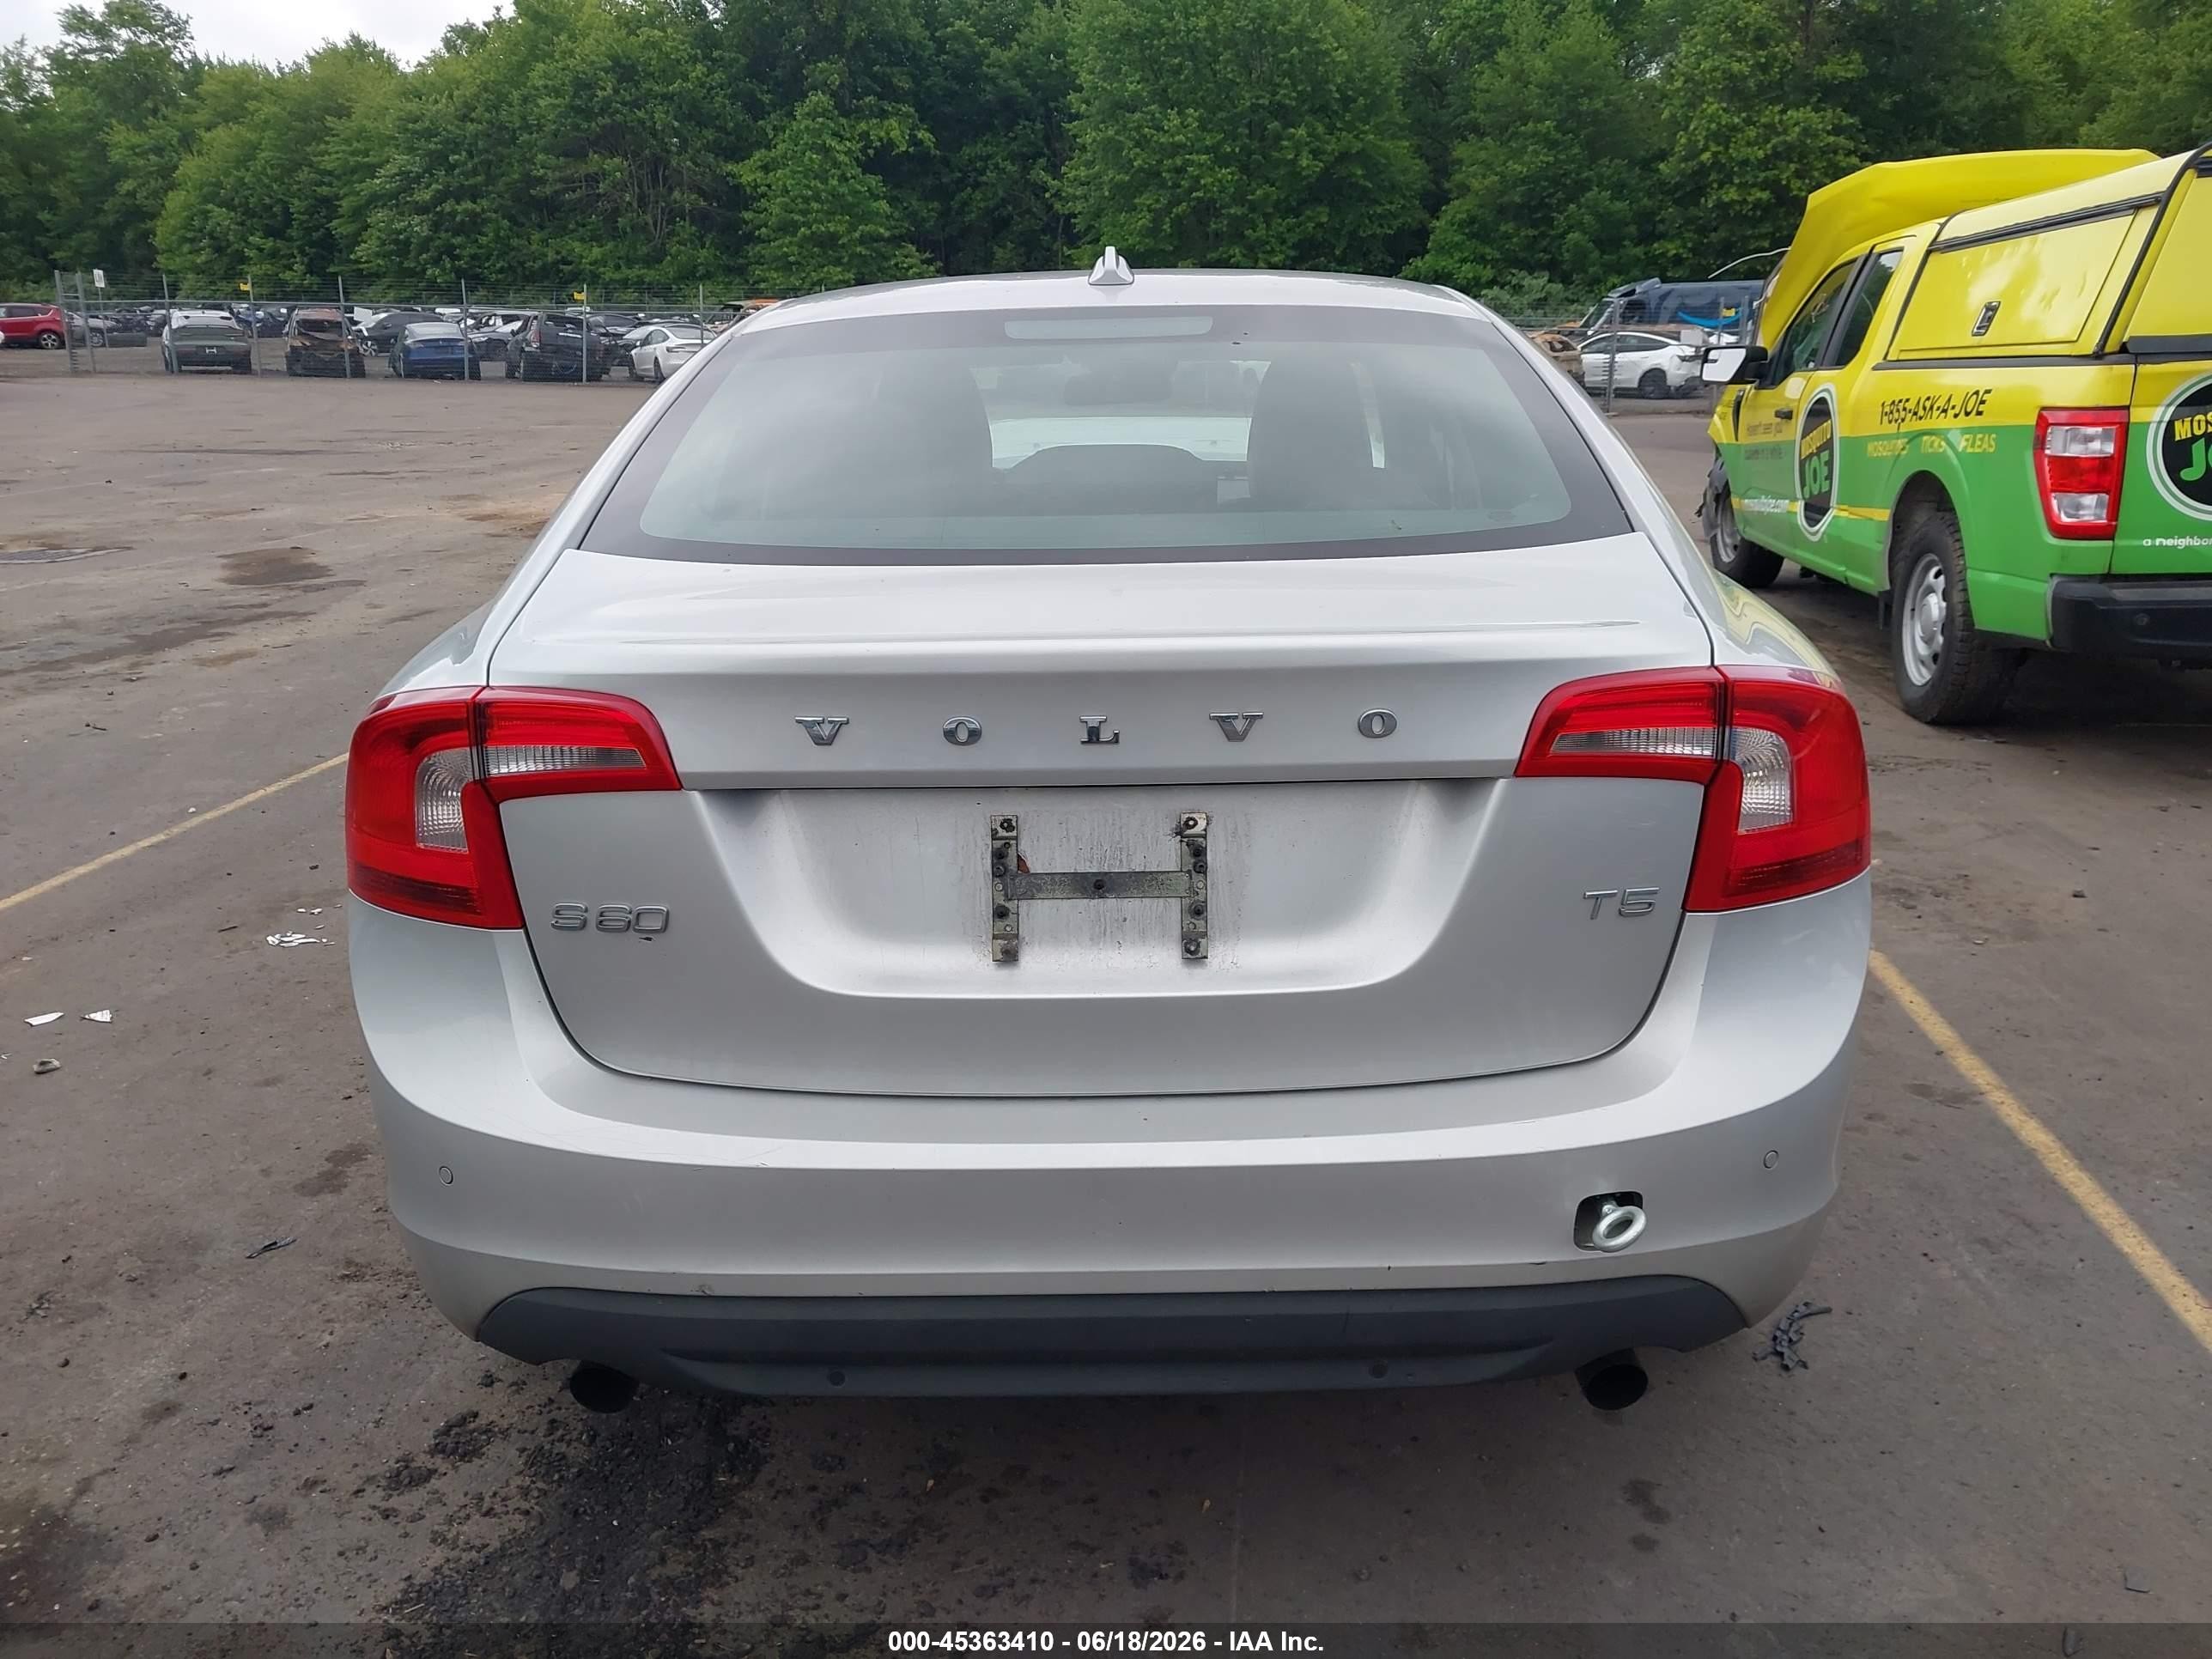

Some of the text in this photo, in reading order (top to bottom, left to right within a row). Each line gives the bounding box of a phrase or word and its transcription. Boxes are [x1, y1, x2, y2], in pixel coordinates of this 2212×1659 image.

[1880, 389, 1992, 425] 1-855-ASK-A-JOE
[1959, 434, 1996, 453] FLEAS
[2180, 437, 2212, 481] J
[1803, 449, 1830, 499] JOE
[2143, 538, 2152, 547] a
[794, 707, 1398, 746] VOLVO
[550, 902, 670, 934] S60
[1583, 886, 1660, 921] T5
